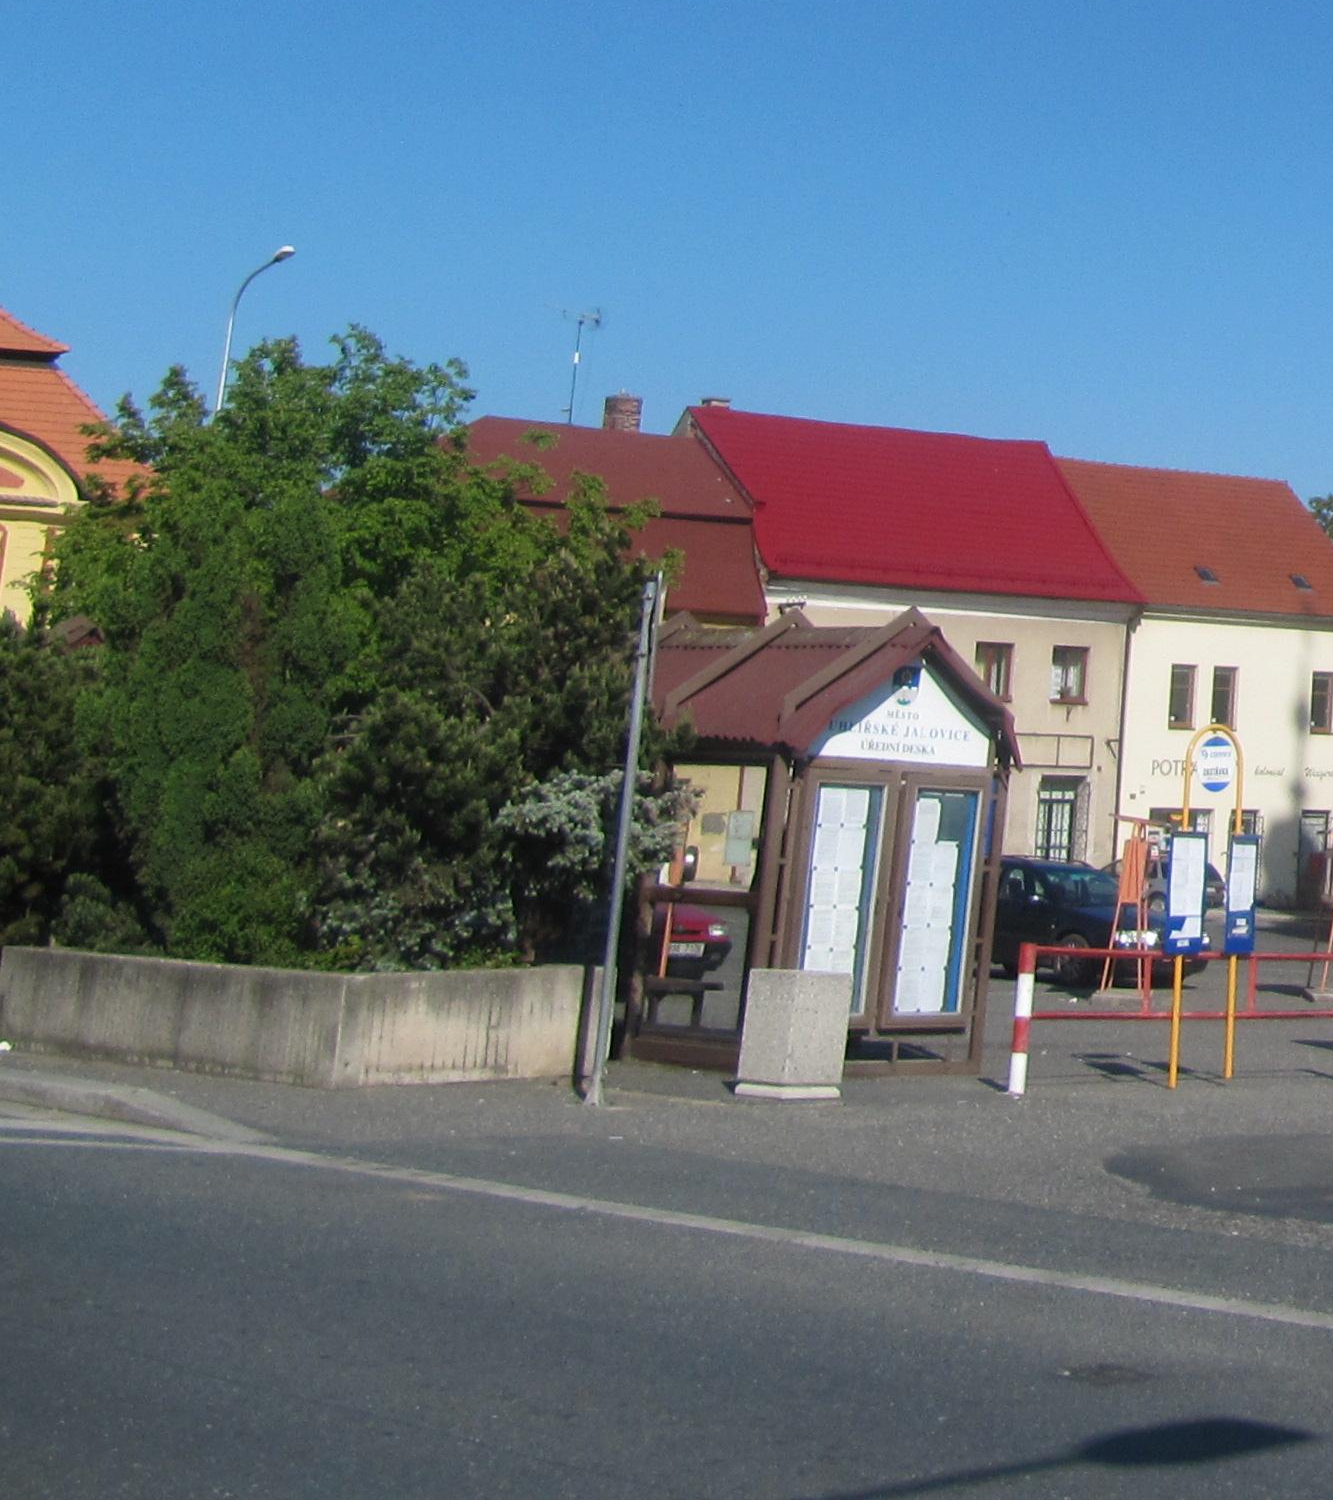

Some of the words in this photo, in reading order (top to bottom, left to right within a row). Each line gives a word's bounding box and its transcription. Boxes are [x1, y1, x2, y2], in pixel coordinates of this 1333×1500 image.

[886, 709, 920, 721] MĚSTO
[903, 727, 972, 742] JAOVICE
[902, 744, 936, 756] DESKA
